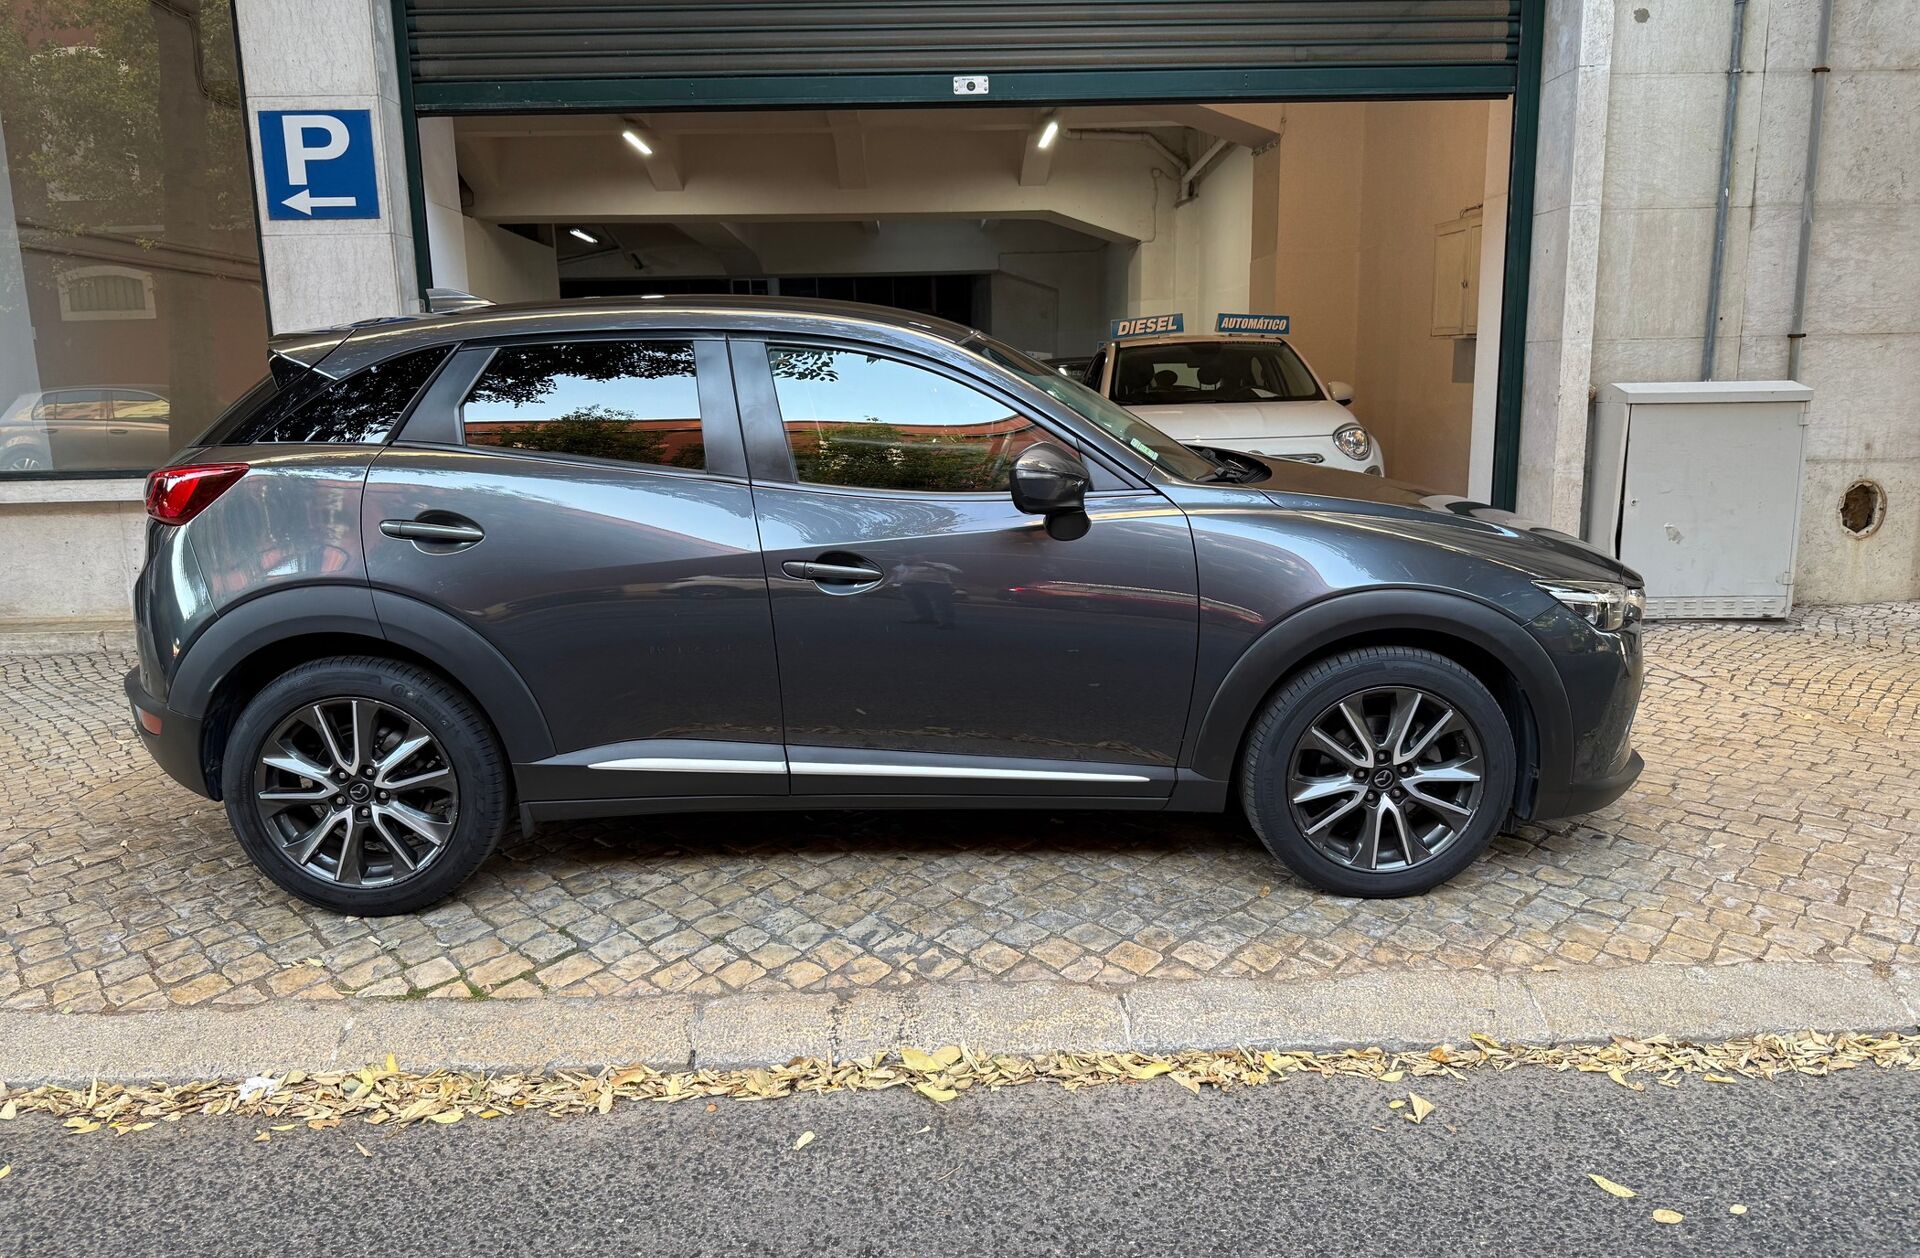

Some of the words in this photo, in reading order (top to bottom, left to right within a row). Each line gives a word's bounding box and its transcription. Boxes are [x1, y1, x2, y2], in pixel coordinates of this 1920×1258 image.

[282, 115, 350, 185] P
[1118, 316, 1177, 335] DIESEL
[1221, 317, 1287, 330] AUTOMÁTICO
[391, 683, 456, 731] Coinentl
